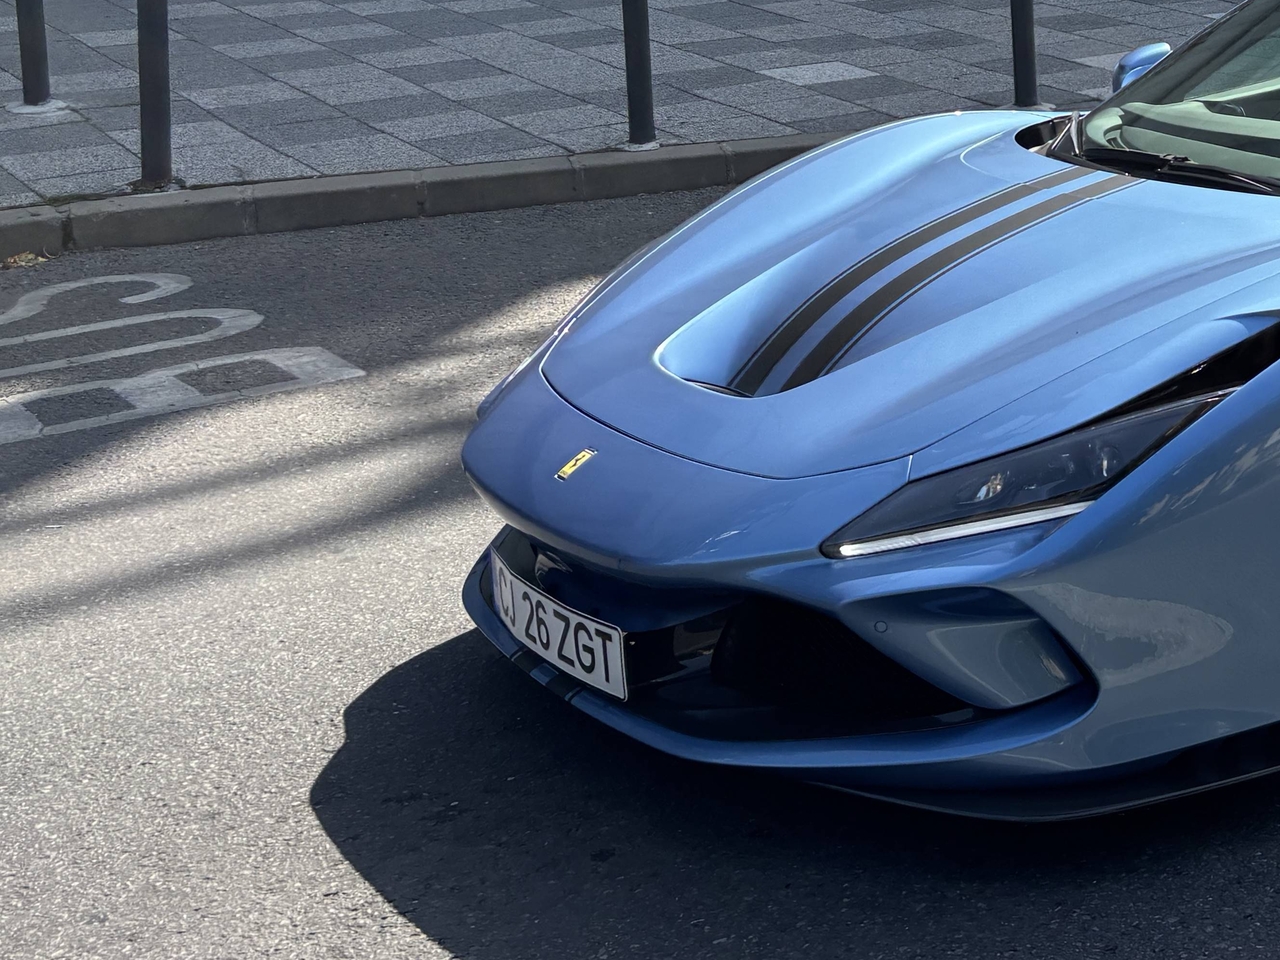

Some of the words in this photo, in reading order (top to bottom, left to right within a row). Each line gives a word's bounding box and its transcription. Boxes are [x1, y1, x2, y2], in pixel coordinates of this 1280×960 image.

[499, 566, 516, 628] CJ
[522, 591, 550, 651] 26
[553, 608, 613, 684] ZGT
